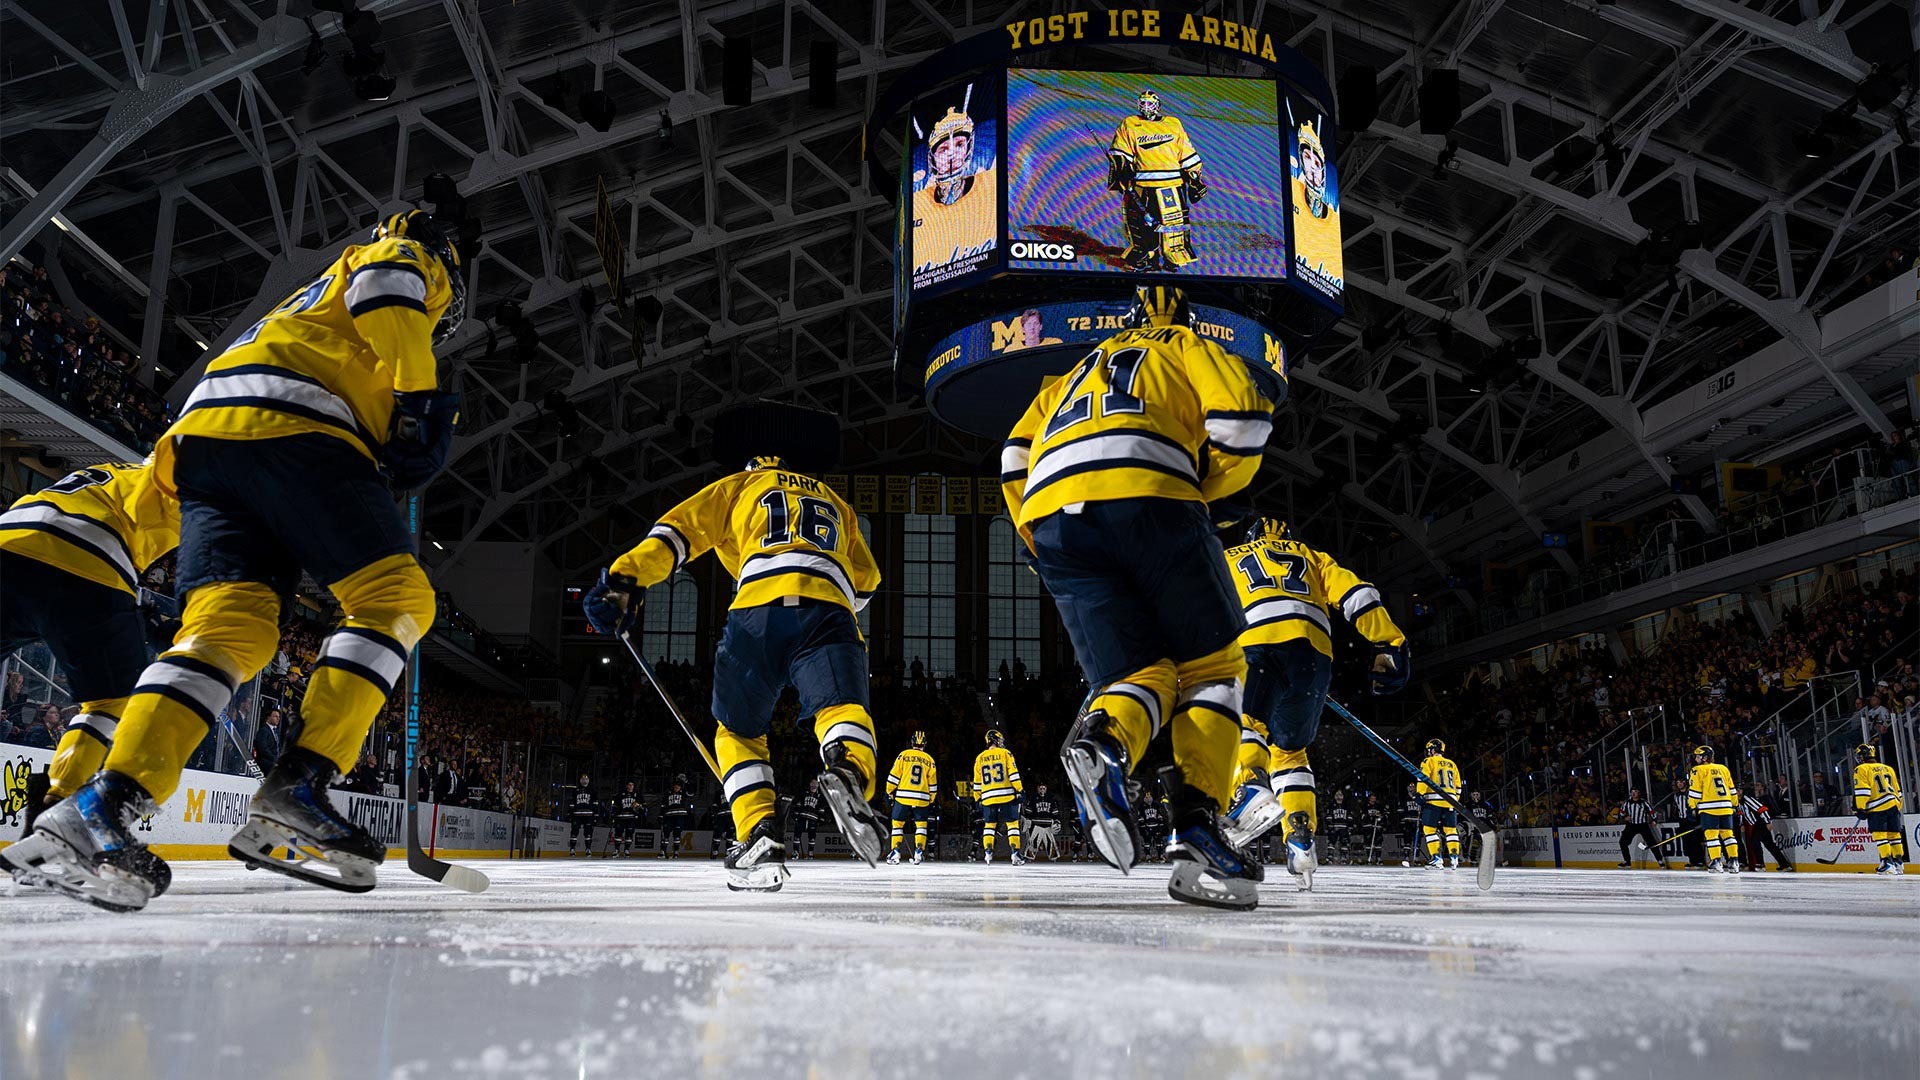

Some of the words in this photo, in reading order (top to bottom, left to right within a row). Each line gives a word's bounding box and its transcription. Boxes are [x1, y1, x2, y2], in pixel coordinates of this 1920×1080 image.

[1006, 11, 1089, 49] YOST
[1108, 9, 1161, 37] ICE
[1179, 13, 1277, 63] ARENA
[953, 252, 989, 270] FRESHMAN
[1010, 242, 1075, 260] OIKOS
[913, 277, 932, 291] FROM
[991, 316, 1024, 351] M
[1067, 317, 1091, 331] 72
[1043, 346, 1149, 440] 21
[777, 471, 823, 494] PARK
[760, 489, 840, 553] 16
[1236, 548, 1311, 595] 17
[911, 765, 922, 785] 9
[981, 763, 1005, 785] 63
[1715, 777, 1727, 796] 5
[184, 788, 206, 824] M
[209, 790, 250, 825] MICHIGAN
[348, 796, 404, 844] MICHIGAN
[1612, 830, 1621, 838] AR
[1775, 831, 1814, 850] Buddy's
[1845, 844, 1865, 852] PIZZA
